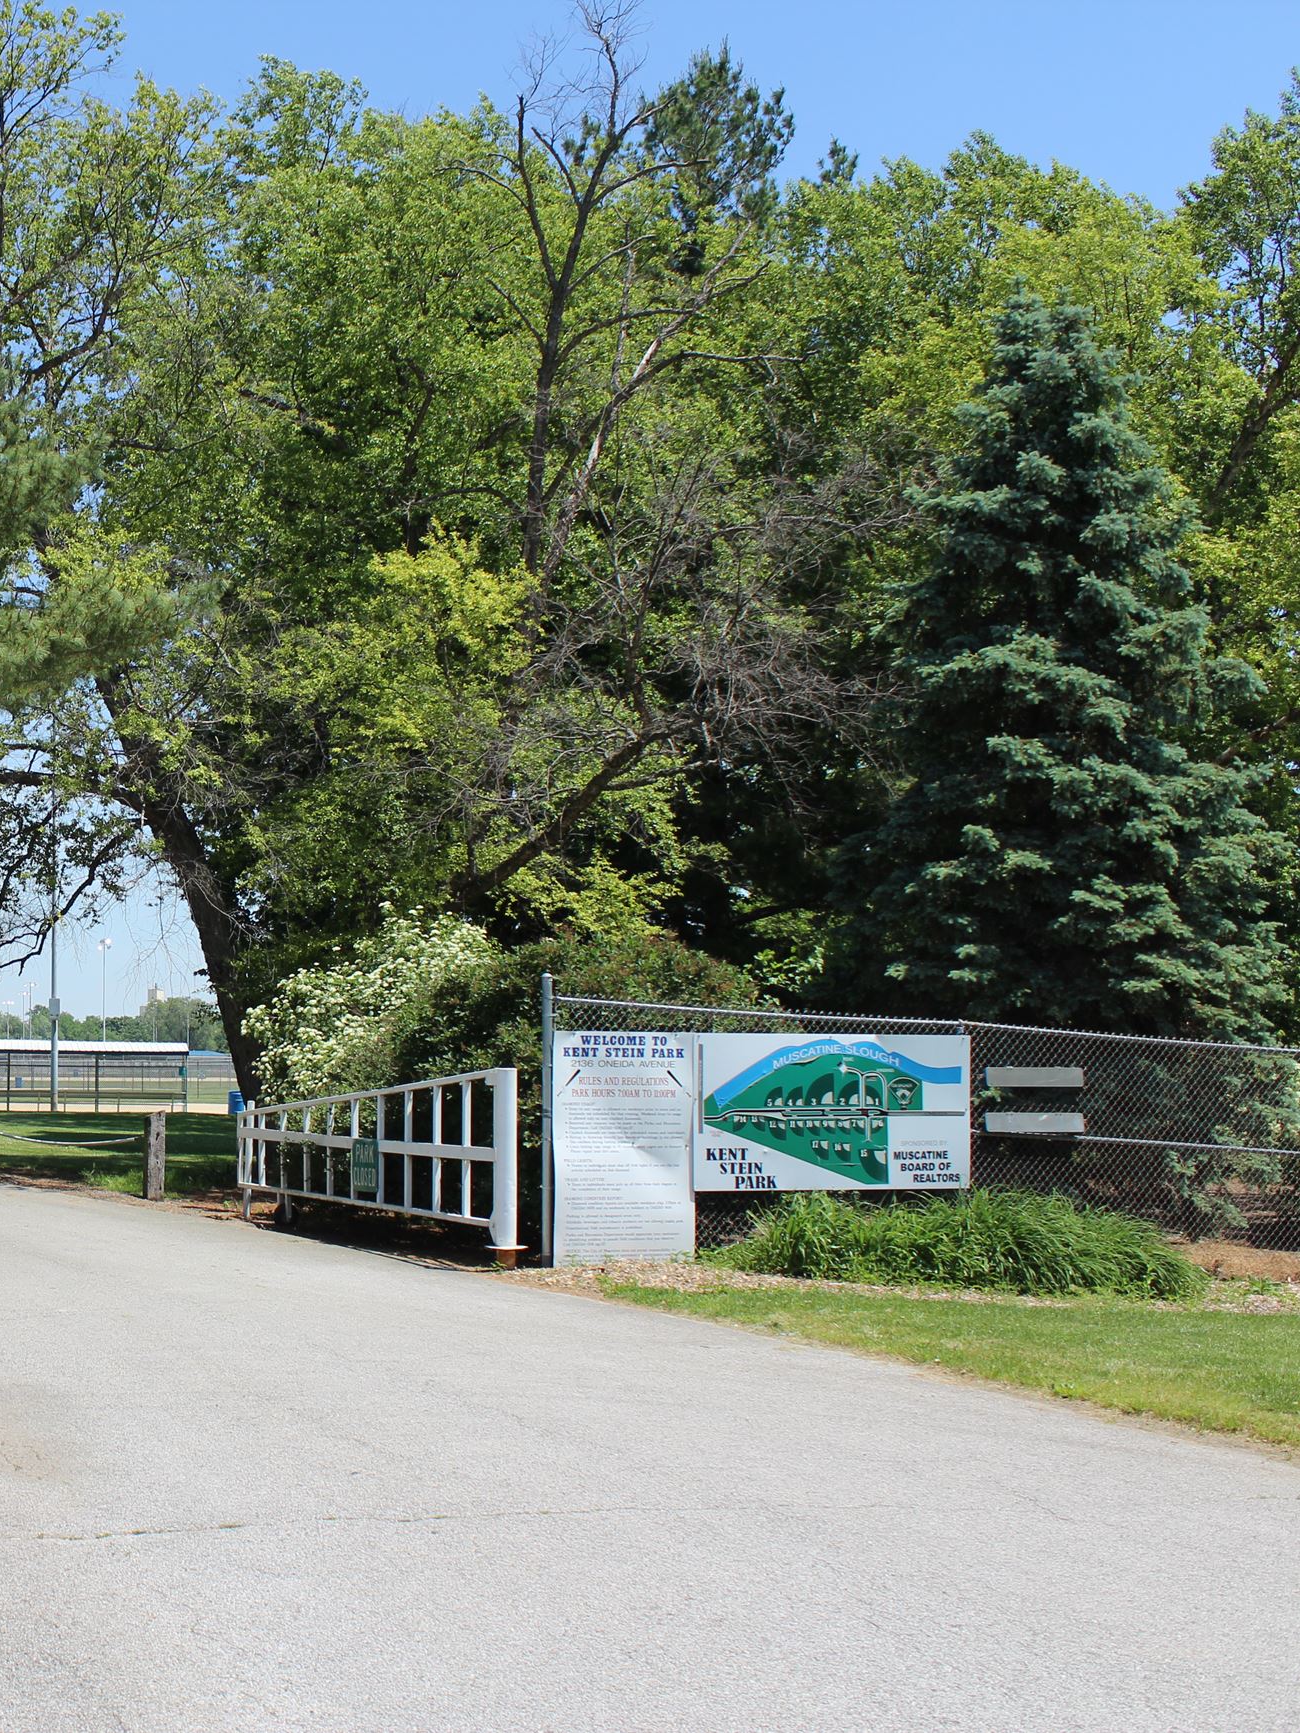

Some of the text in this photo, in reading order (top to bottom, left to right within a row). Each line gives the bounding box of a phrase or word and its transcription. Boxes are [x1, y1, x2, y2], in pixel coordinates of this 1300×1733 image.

[580, 1035, 668, 1046] WELCOME TO
[563, 1047, 684, 1058] KENT STEIN PARK
[772, 1045, 900, 1070] MUSCATINE SLOUGH
[598, 1060, 635, 1068] ONEIDA
[639, 1060, 676, 1068] AVENUE
[578, 1076, 669, 1086] RULES AND REGULATIONS
[572, 1088, 590, 1098] PARK
[592, 1089, 616, 1098] HOURS
[643, 1089, 652, 1098] TO
[355, 1144, 374, 1164] PARK
[706, 1148, 748, 1160] KENT
[893, 1150, 948, 1160] MUSCATINE
[720, 1162, 763, 1174] STEIN
[900, 1162, 952, 1171] BOARD OF
[353, 1167, 377, 1187] CLOSED
[734, 1176, 777, 1189] PARK
[913, 1173, 960, 1182] REALTORS
